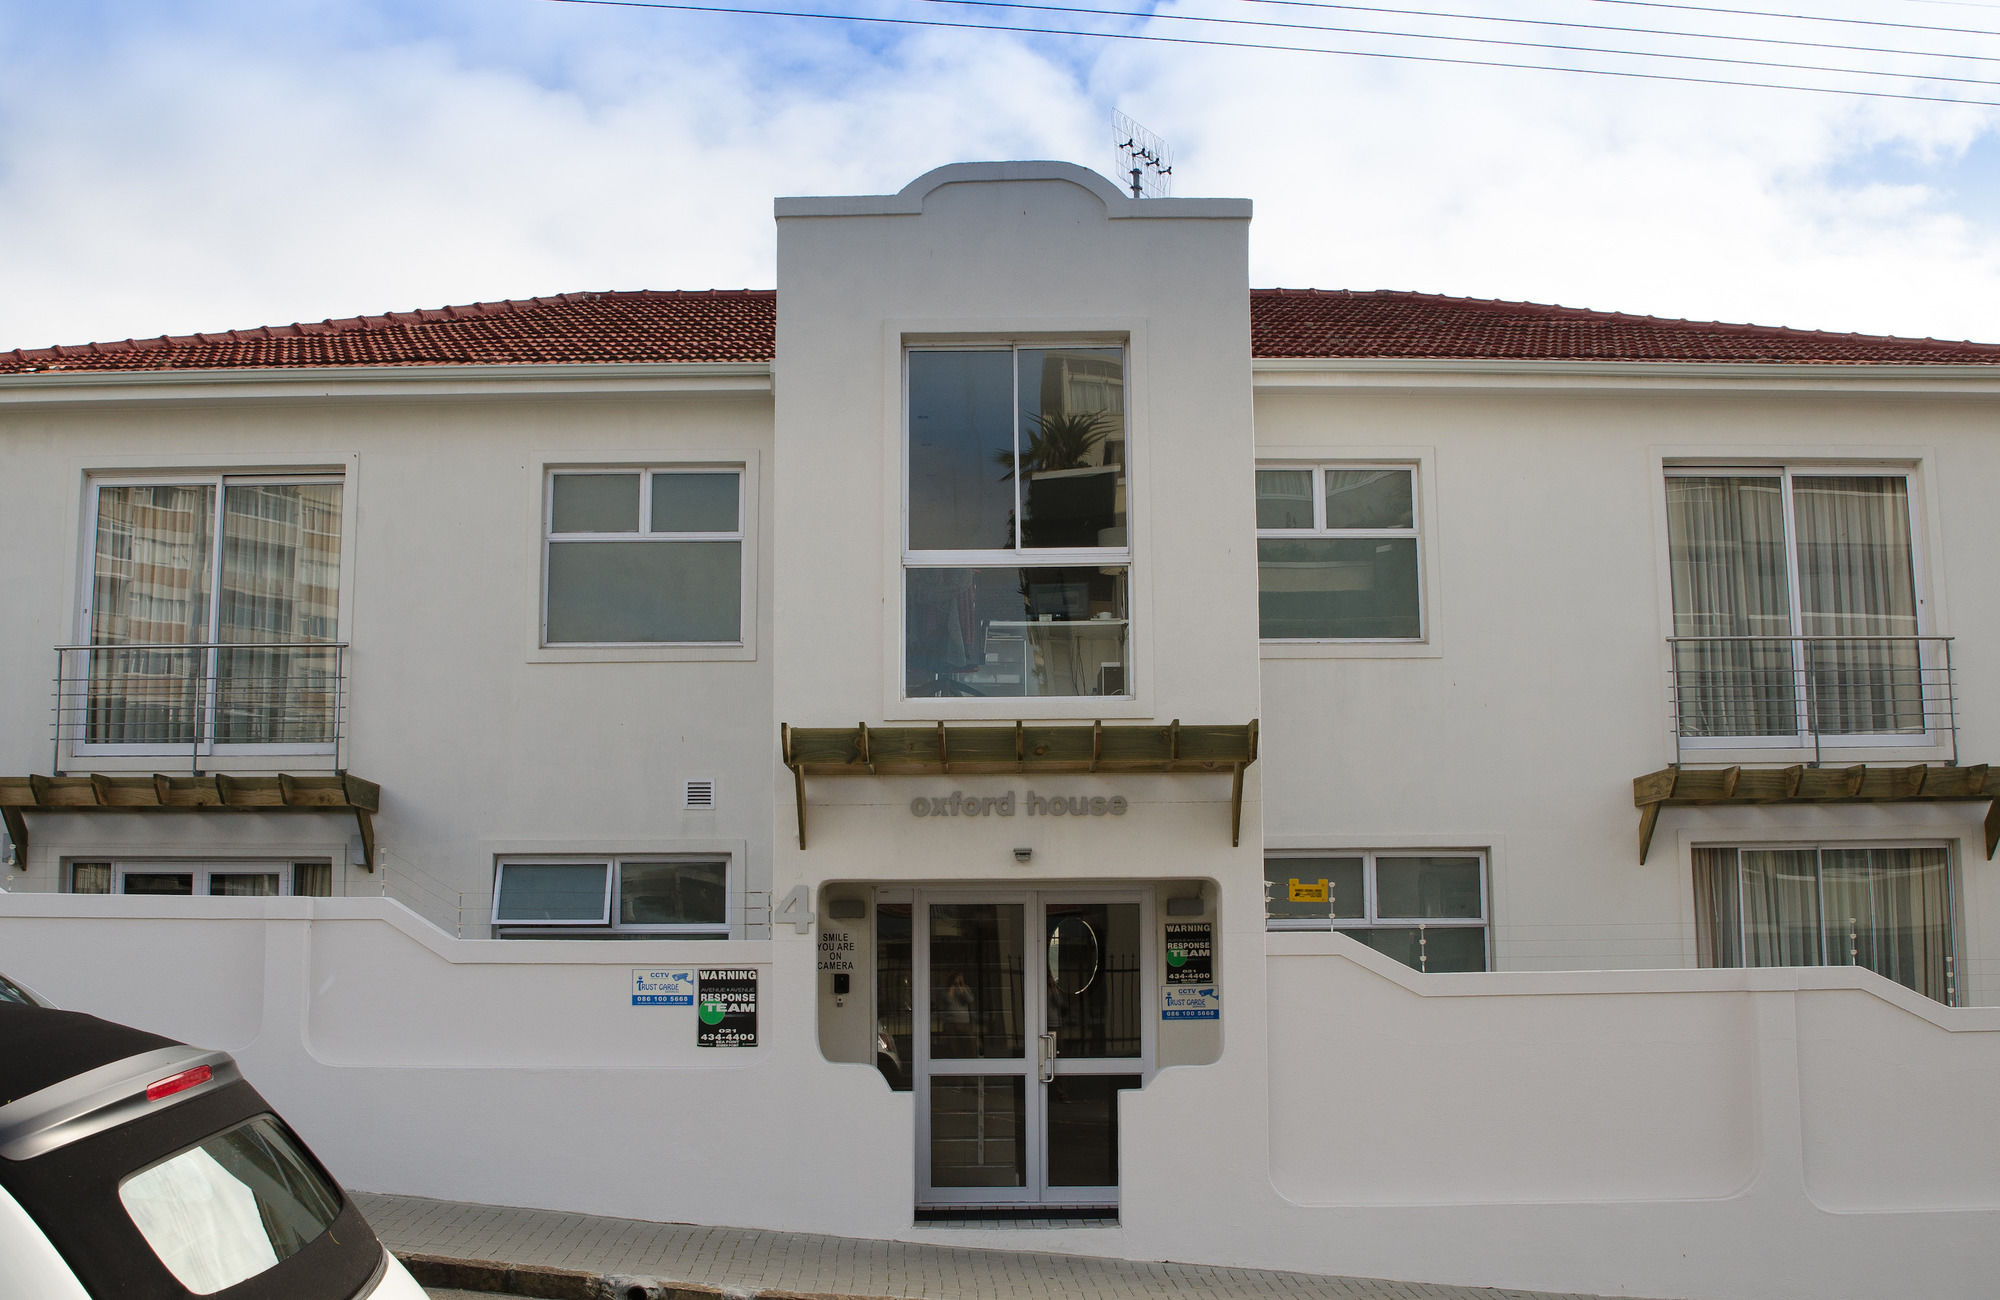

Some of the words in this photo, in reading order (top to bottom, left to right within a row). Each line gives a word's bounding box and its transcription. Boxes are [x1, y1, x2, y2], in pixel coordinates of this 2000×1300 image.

[910, 790, 1016, 818] oxford
[1026, 790, 1129, 817] house
[774, 885, 816, 935] 4
[1166, 924, 1210, 932] WARNING
[822, 933, 849, 942] SMILE
[817, 943, 835, 951] YOU
[837, 943, 855, 951] ARE
[829, 952, 842, 961] ON
[1170, 949, 1210, 957] TEAM
[817, 962, 854, 970] CAMERA
[699, 970, 757, 980] WARNING
[637, 976, 658, 991] TRUST
[700, 993, 756, 1002] RESPONSE
[703, 1002, 756, 1013] TEAM
[700, 1033, 755, 1041] 434-4400
